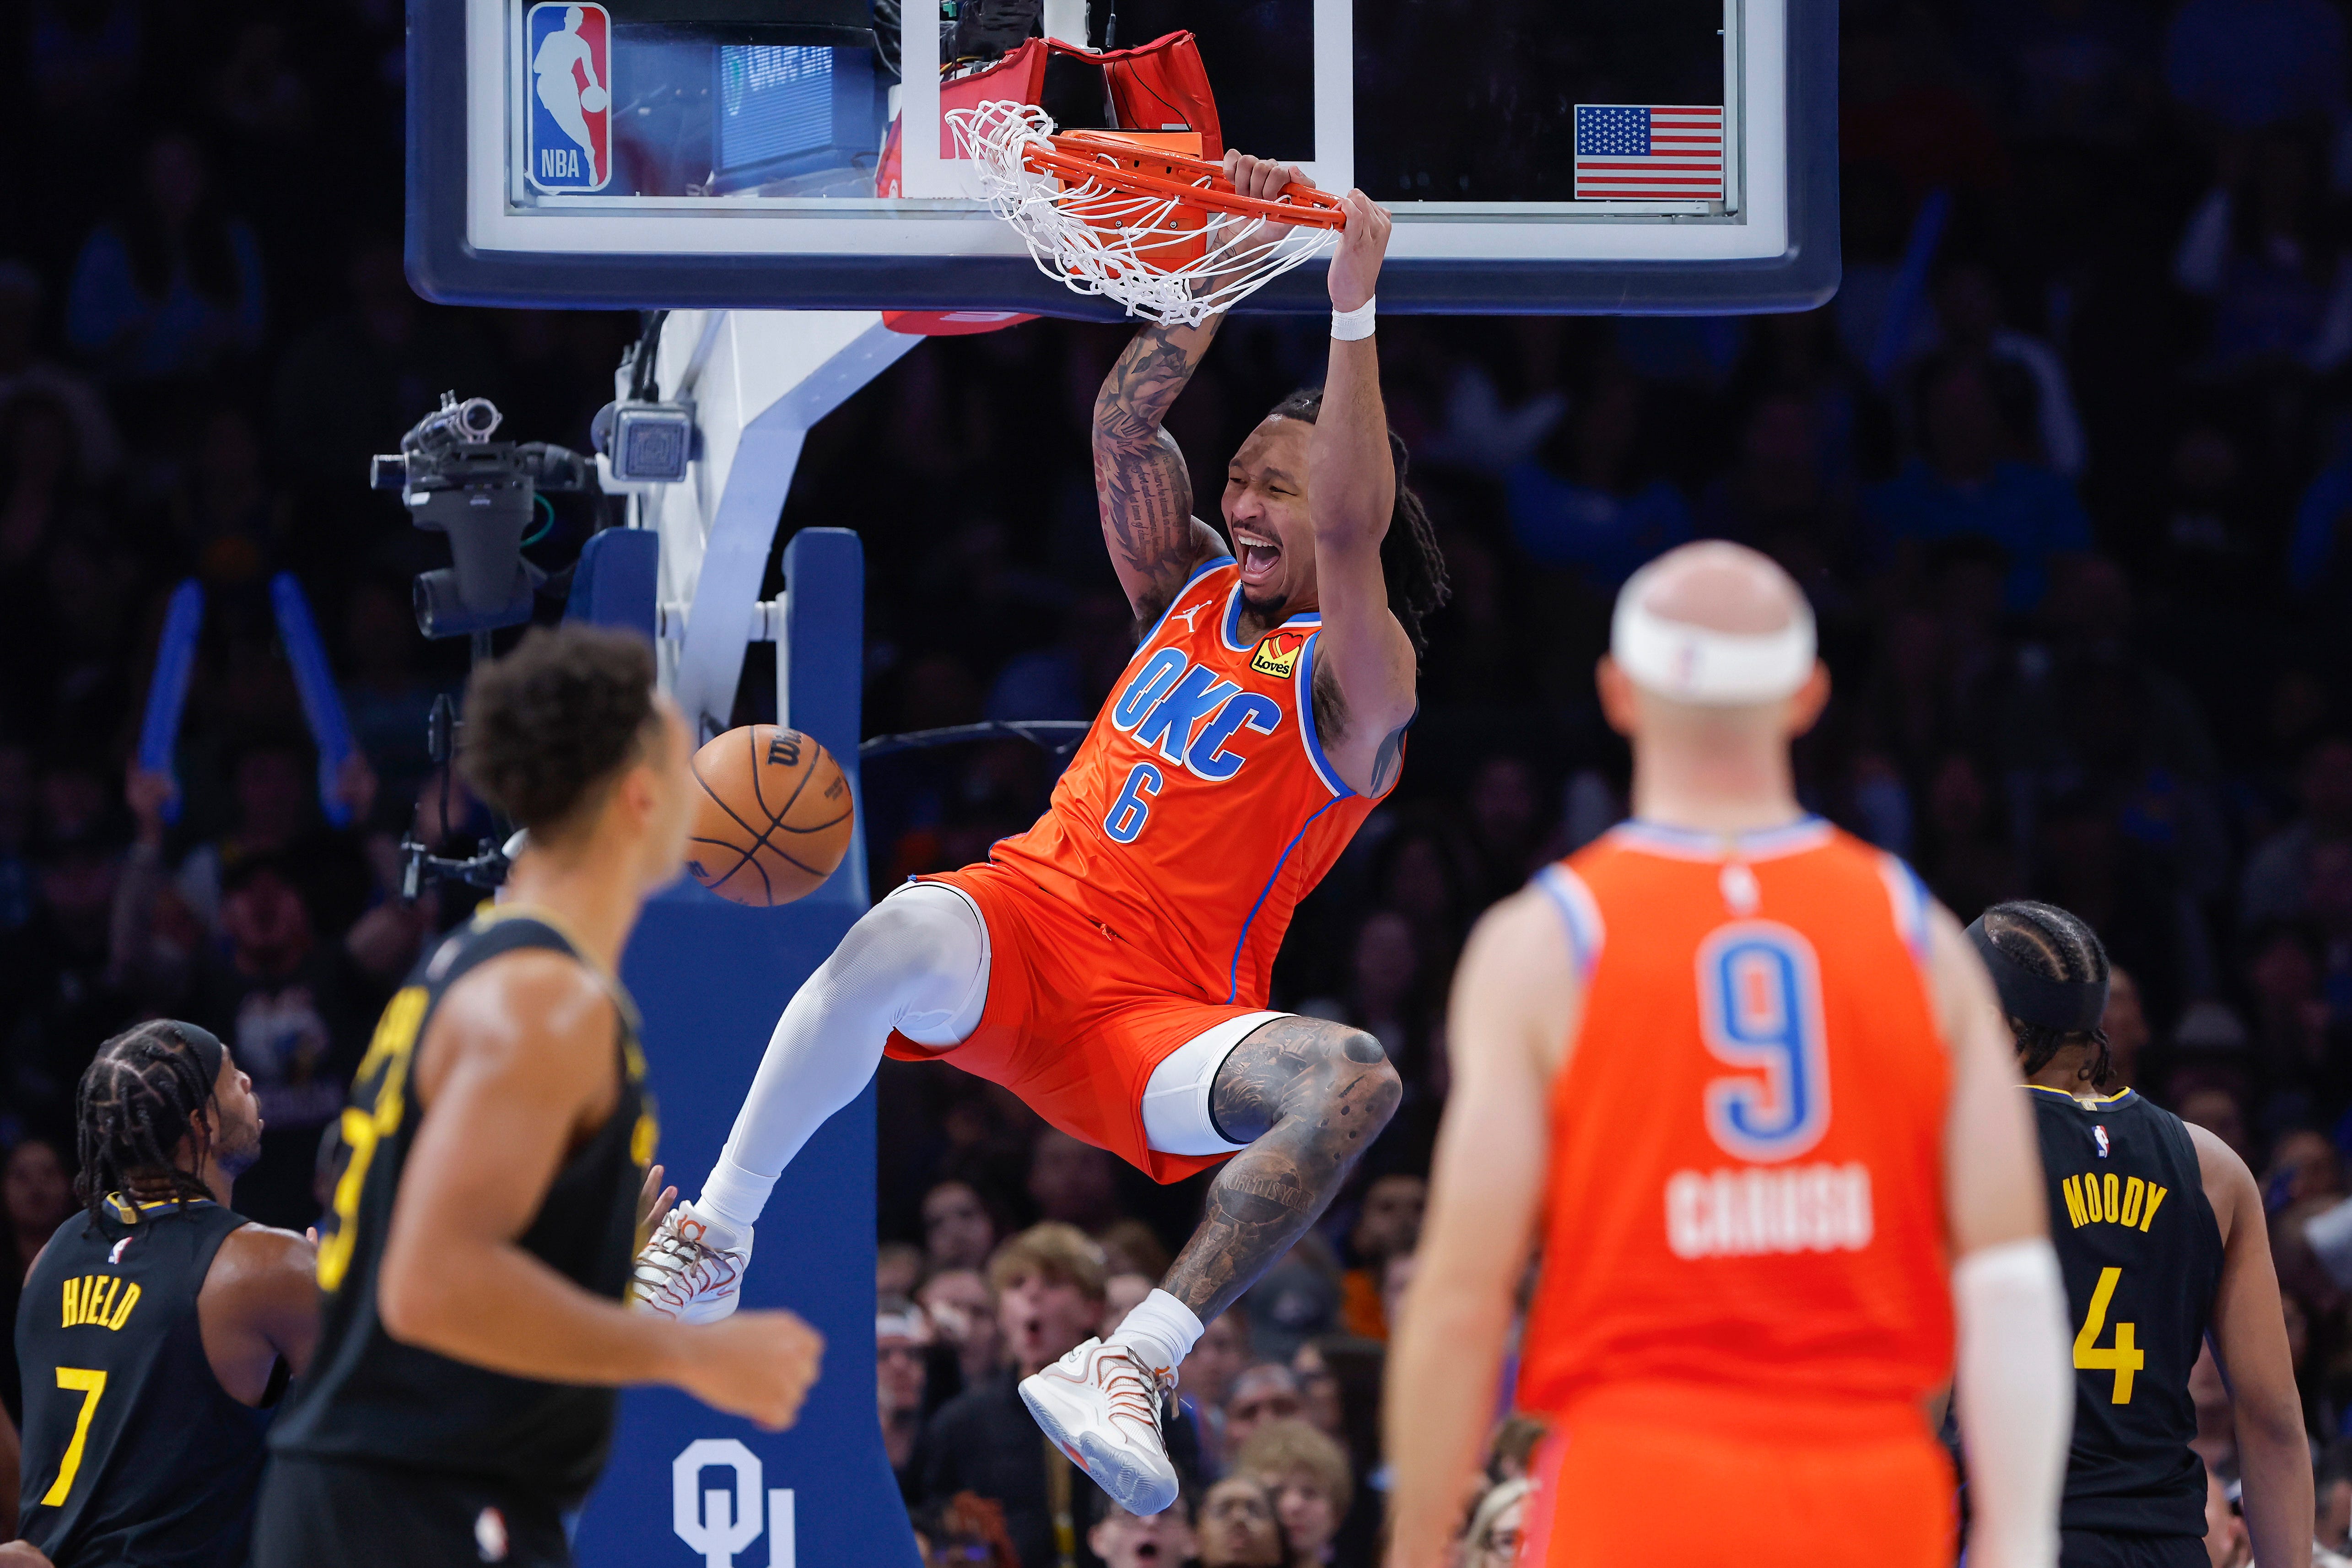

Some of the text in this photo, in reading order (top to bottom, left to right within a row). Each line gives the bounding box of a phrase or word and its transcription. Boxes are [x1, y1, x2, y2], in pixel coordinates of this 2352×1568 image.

[541, 149, 579, 178] NBA
[1111, 647, 1283, 781] OKC
[1103, 762, 1164, 844] 6
[1695, 920, 1832, 1163] 9
[2062, 1172, 2168, 1233] MOODY
[61, 1274, 142, 1331] HIELD
[2073, 1267, 2144, 1405] 4
[40, 1366, 108, 1507] 7
